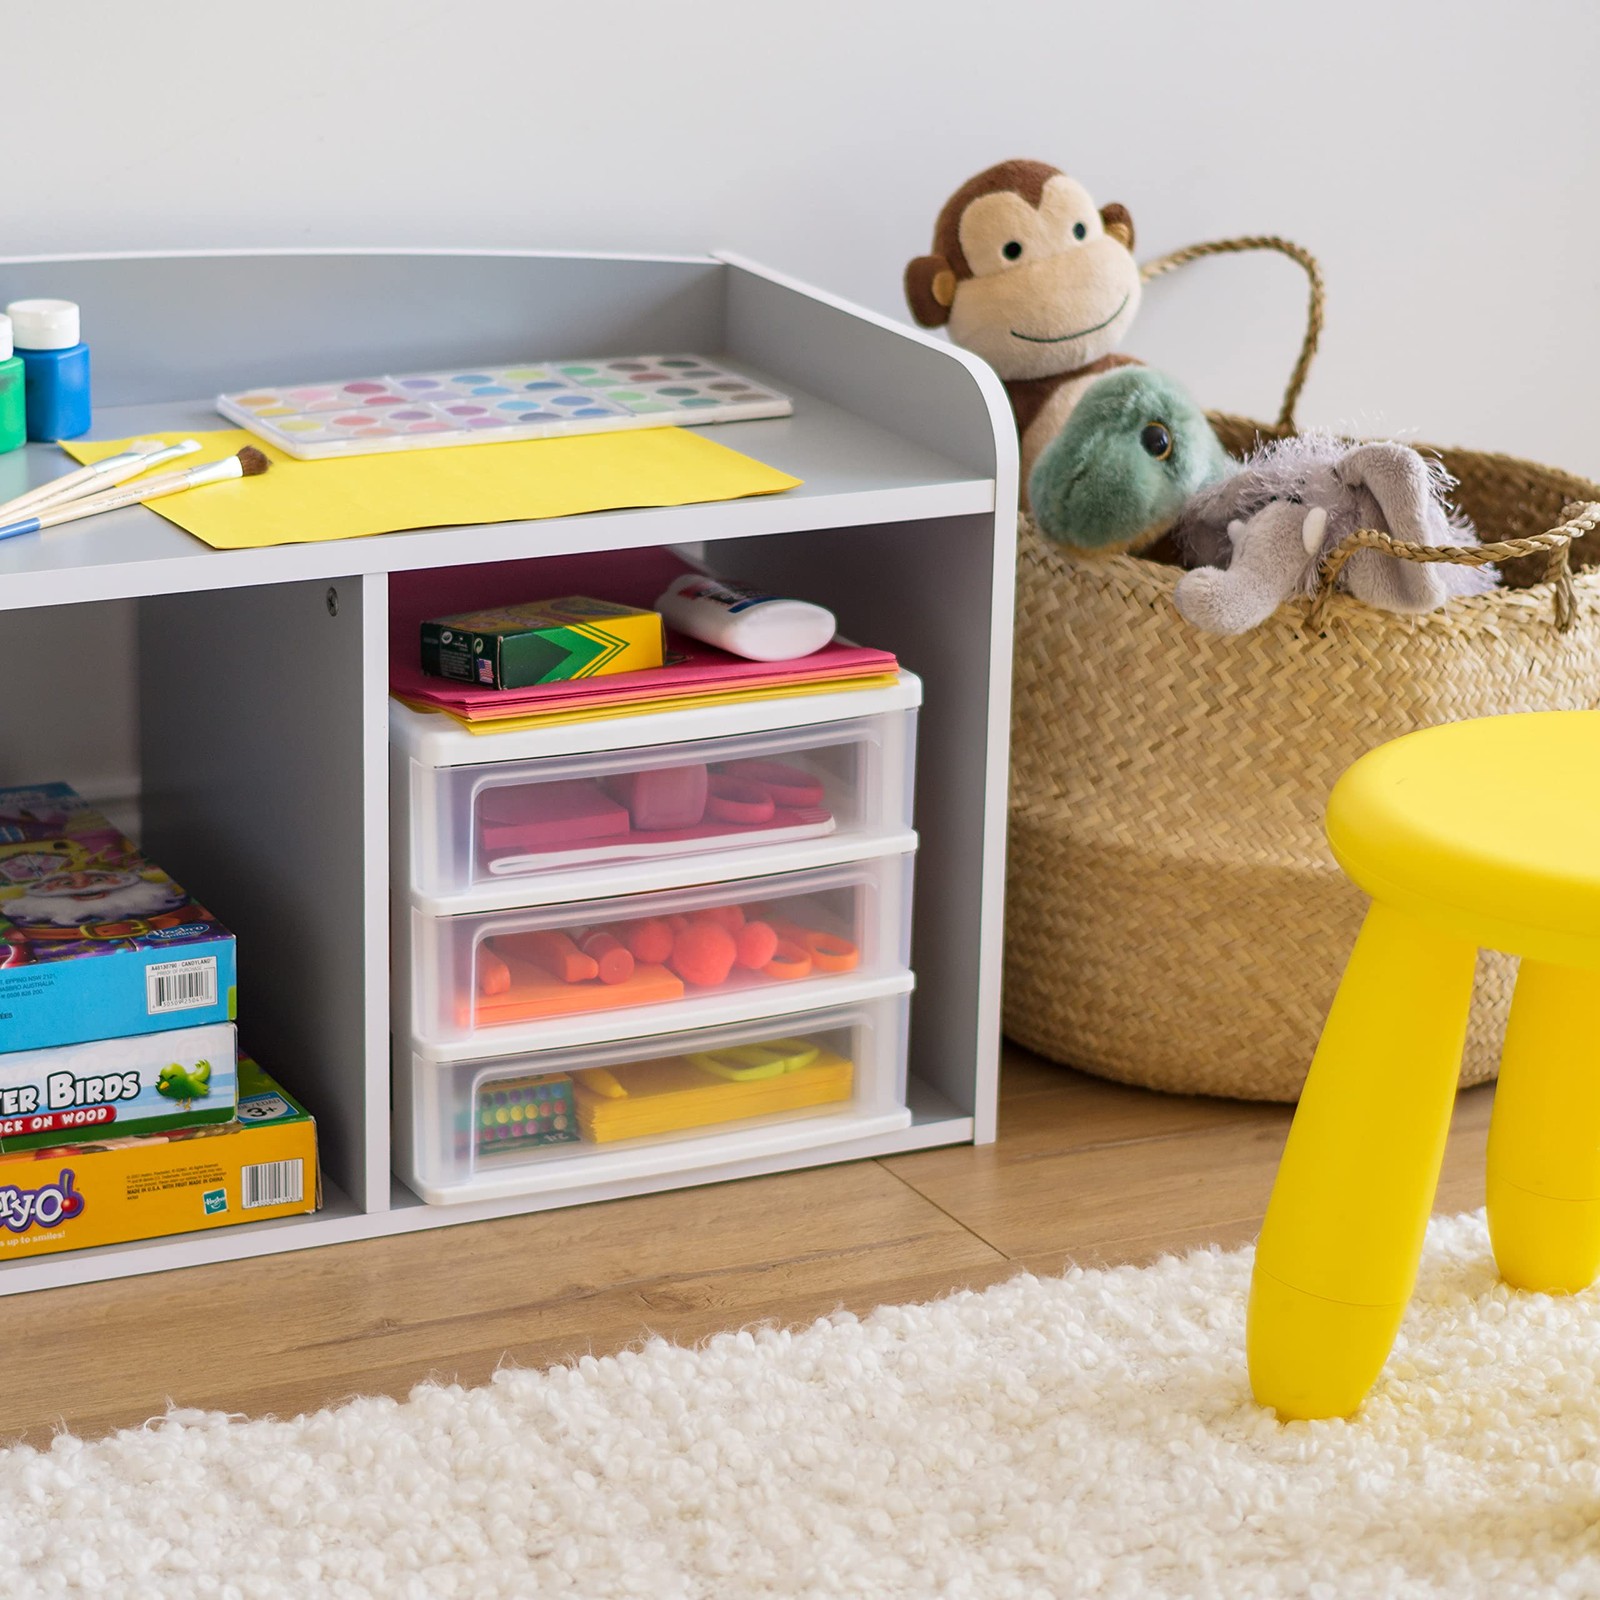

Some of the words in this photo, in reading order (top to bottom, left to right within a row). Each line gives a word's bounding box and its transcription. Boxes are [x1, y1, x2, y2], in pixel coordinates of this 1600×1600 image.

[0, 1084, 39, 1116] ER
[48, 1071, 140, 1110] BIRDS
[31, 1117, 53, 1130] ON
[61, 1107, 108, 1126] WOOD
[7, 1238, 19, 1247] up
[21, 1236, 31, 1244] to
[32, 1229, 66, 1242] smiles!
